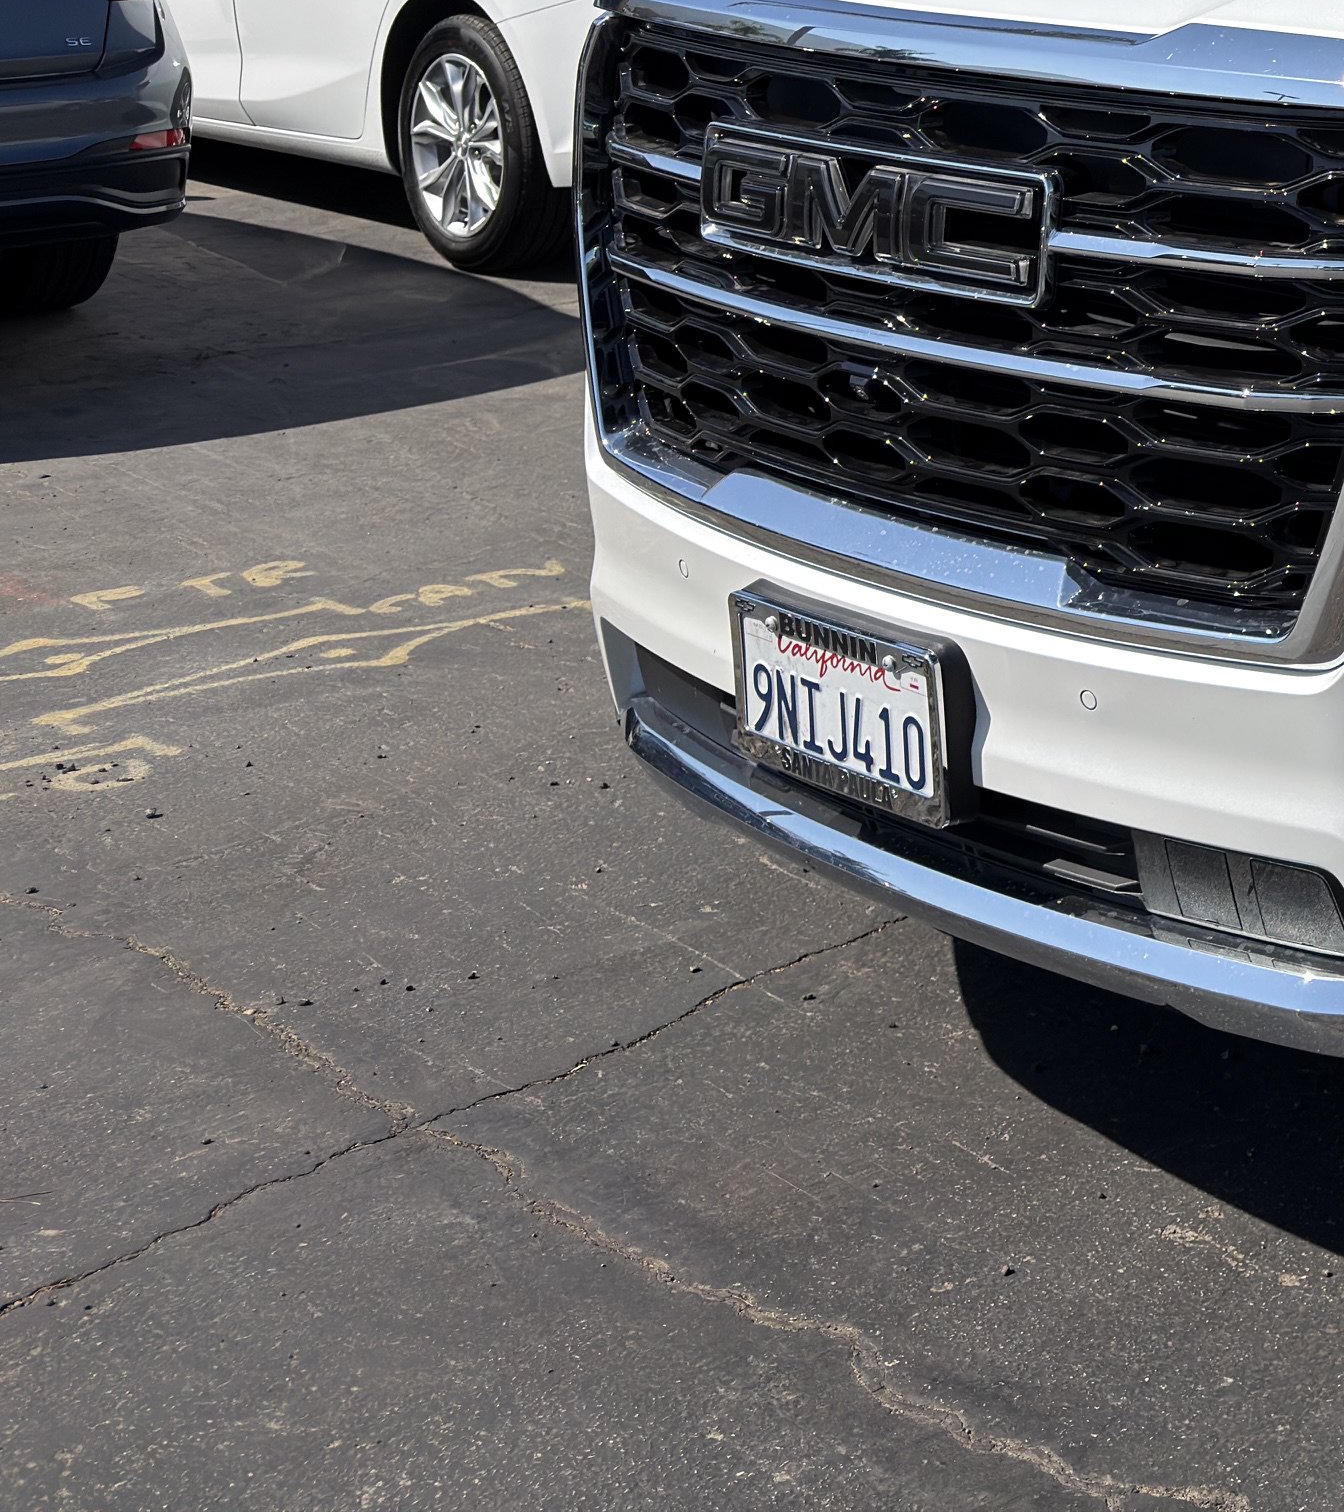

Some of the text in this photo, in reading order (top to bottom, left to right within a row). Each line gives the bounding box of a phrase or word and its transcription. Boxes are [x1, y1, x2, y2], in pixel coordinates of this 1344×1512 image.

[65, 37, 92, 47] SE
[701, 138, 1037, 287] GMC
[776, 634, 901, 693] California
[778, 611, 878, 665] BUNNIN
[753, 663, 926, 791] 9NIJ410
